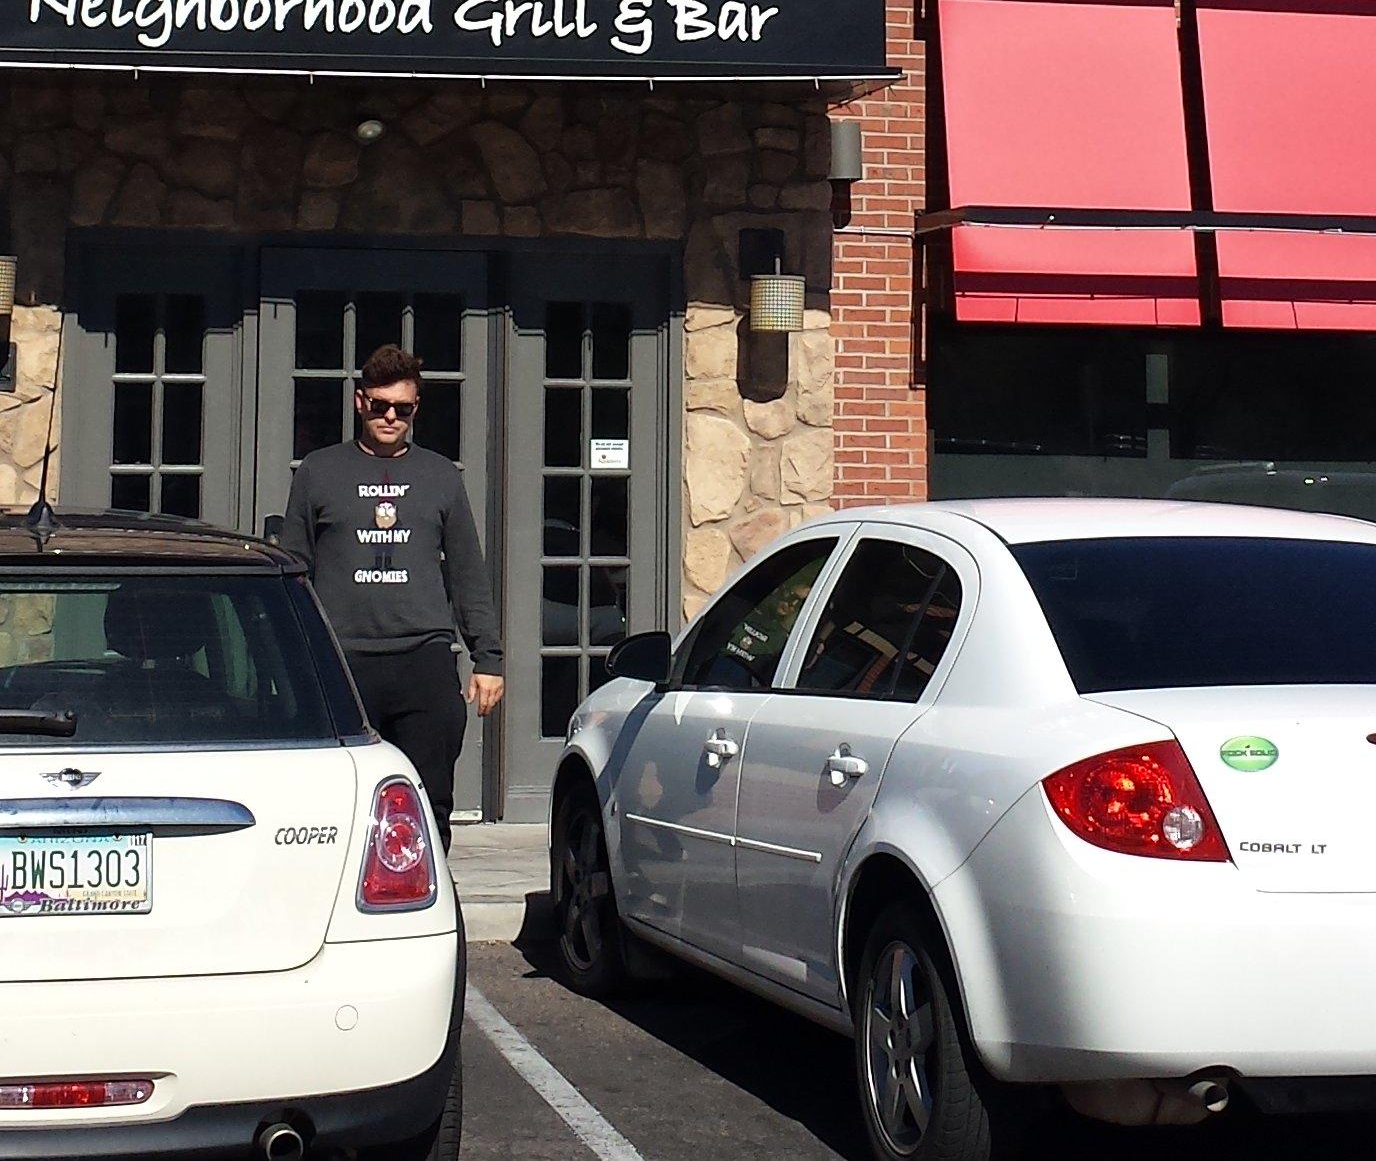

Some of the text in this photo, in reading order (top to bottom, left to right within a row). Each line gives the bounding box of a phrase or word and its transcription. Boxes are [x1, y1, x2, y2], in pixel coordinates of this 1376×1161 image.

[358, 484, 411, 498] ROLLIN'
[356, 529, 411, 543] WITH MY
[354, 569, 409, 583] GNOMIES
[274, 825, 338, 845] COOPER
[1239, 842, 1327, 855] COBALT LT
[11, 849, 141, 889] BWS1303
[39, 897, 141, 912] Baltimore
